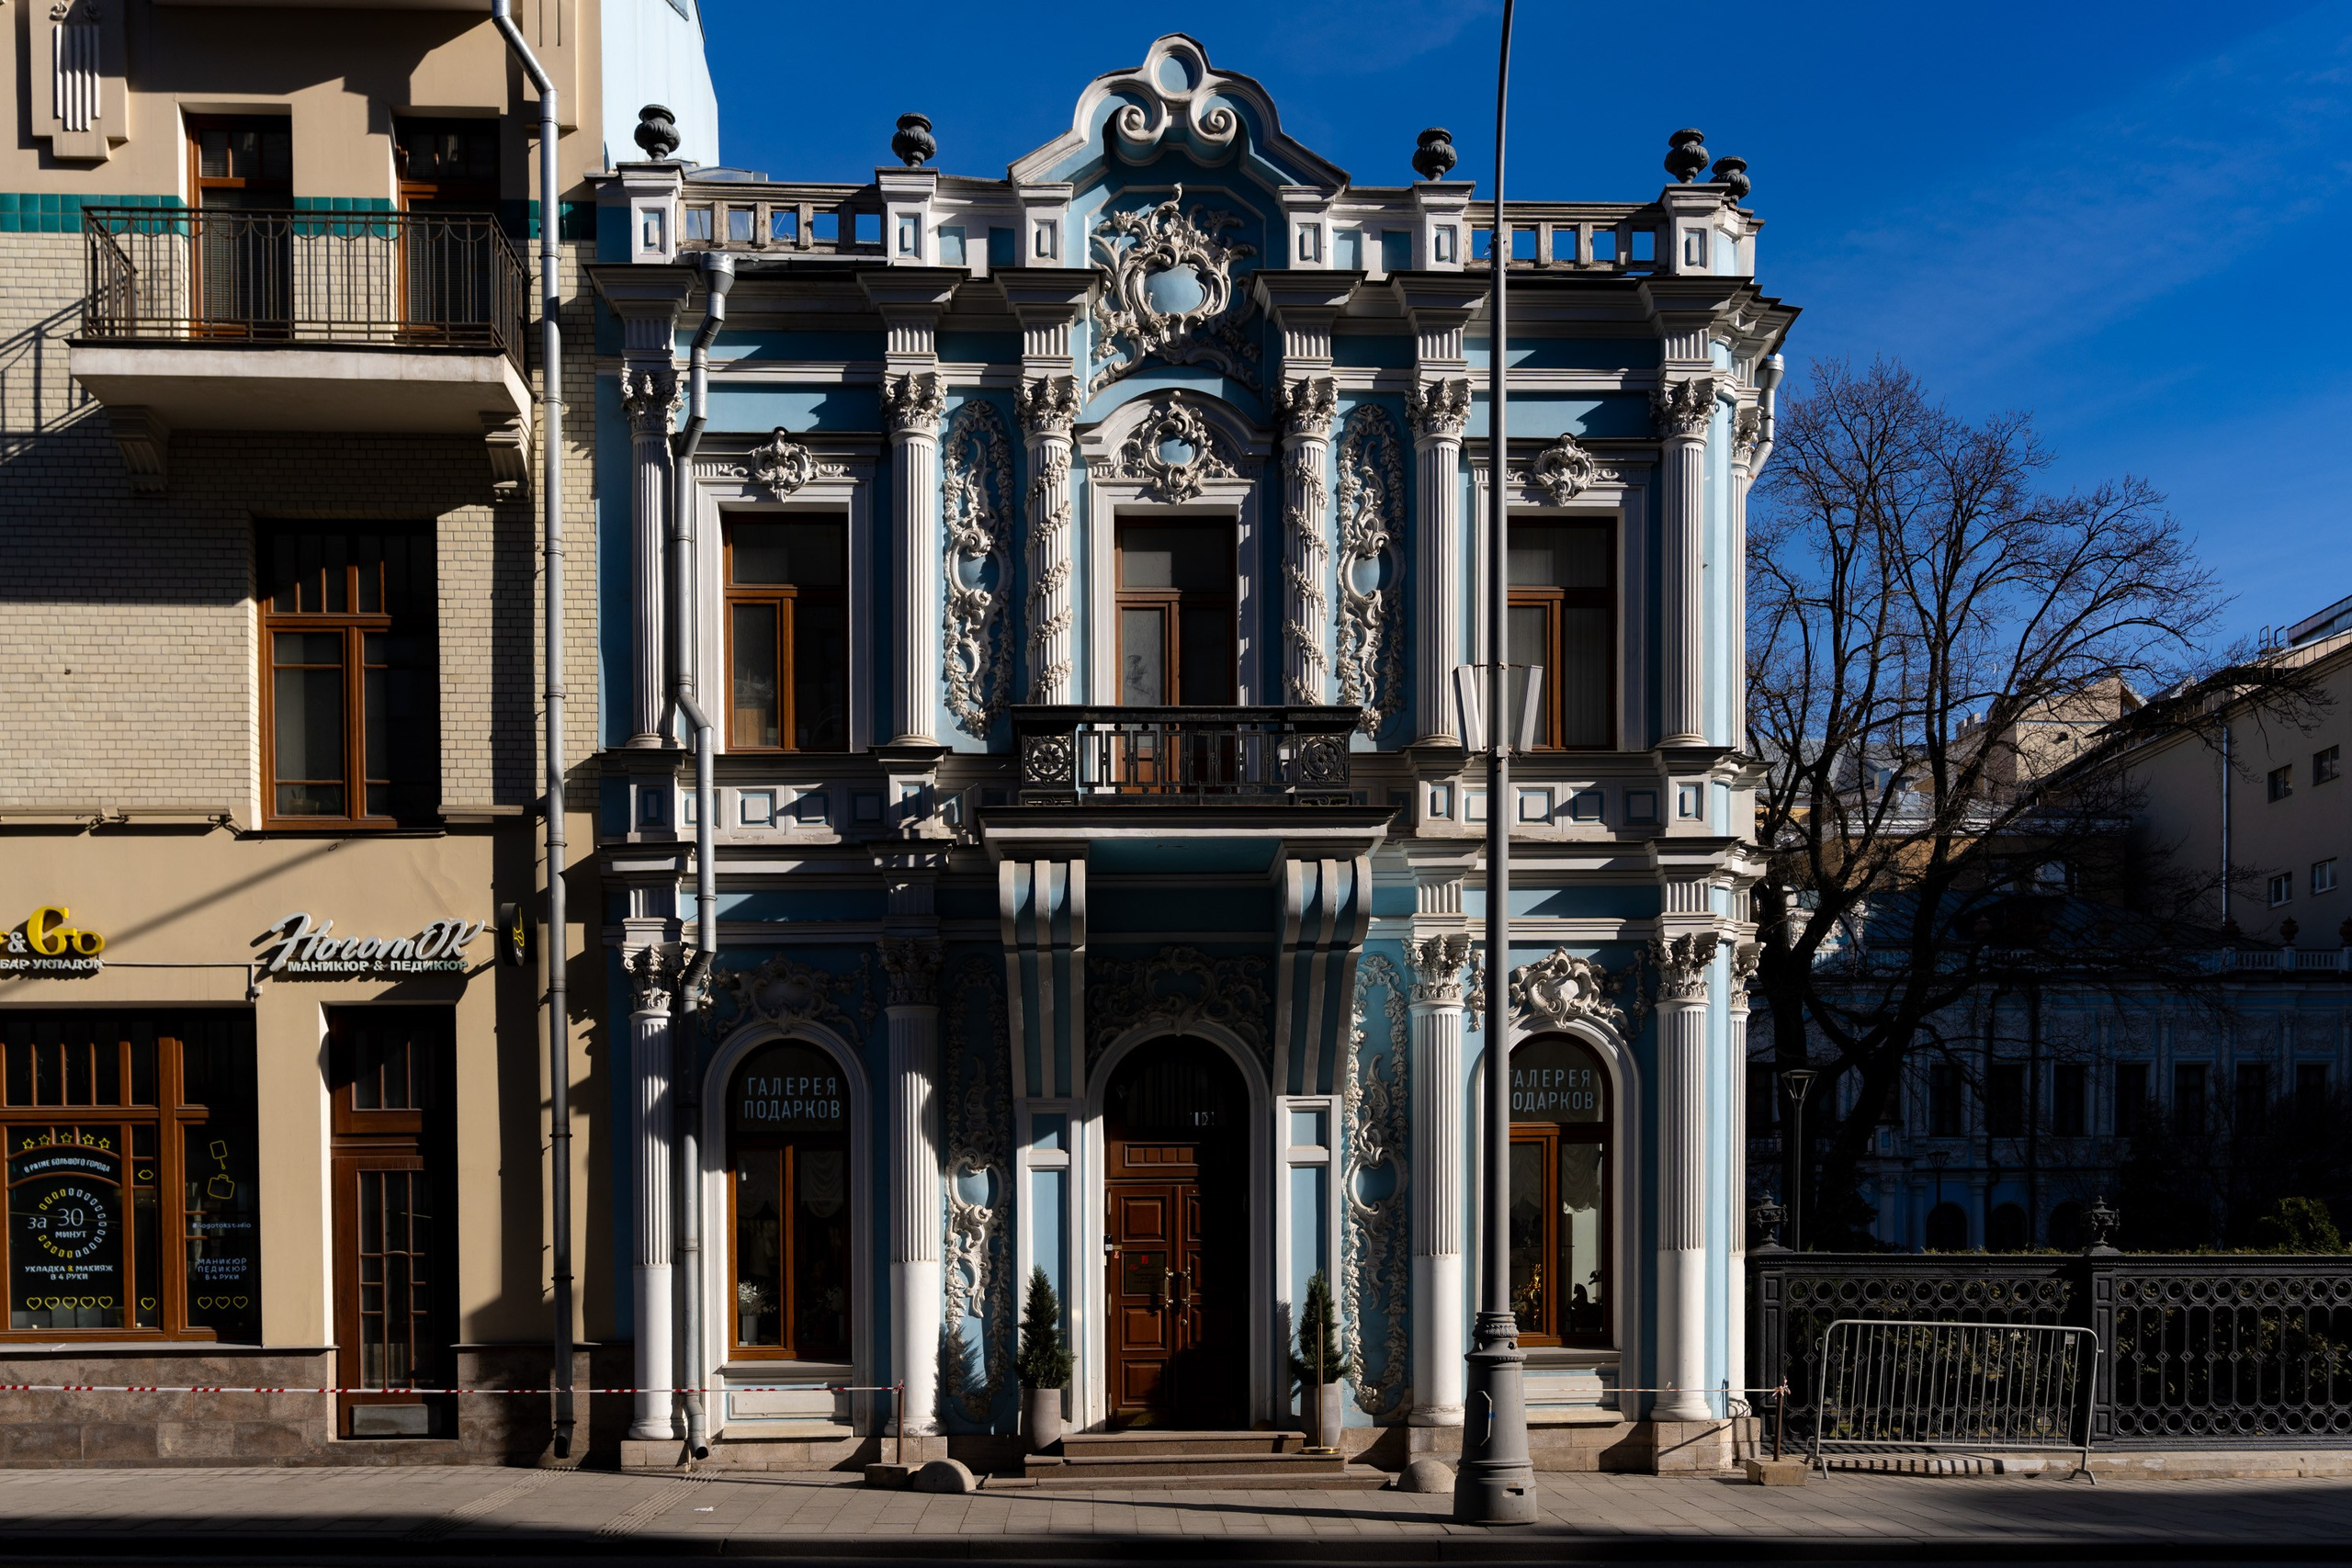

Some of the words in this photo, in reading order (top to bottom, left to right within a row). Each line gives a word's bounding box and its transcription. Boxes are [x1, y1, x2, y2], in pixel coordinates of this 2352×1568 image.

[7, 931, 28, 953] &
[27, 906, 106, 955] Go
[0, 958, 30, 970] БАР
[32, 959, 105, 971] УКЛАДОК
[288, 961, 369, 972] МАНИКЮР
[373, 960, 385, 972] &
[390, 961, 469, 974] ПЕДИКЮР
[747, 1077, 837, 1097] ГАЛЕРЕЯ
[1512, 1091, 1595, 1113] ОДАРКОВ
[743, 1100, 842, 1122] ПОДАРКОВ
[28, 1159, 51, 1172] РИТМЕ
[51, 1157, 86, 1167] БОЛЬШОГО
[85, 1159, 111, 1173] ГОРОДА
[57, 1208, 85, 1226] 30
[197, 1258, 248, 1266] МАНИКЮР
[197, 1265, 248, 1273] ПЕДИКЮР
